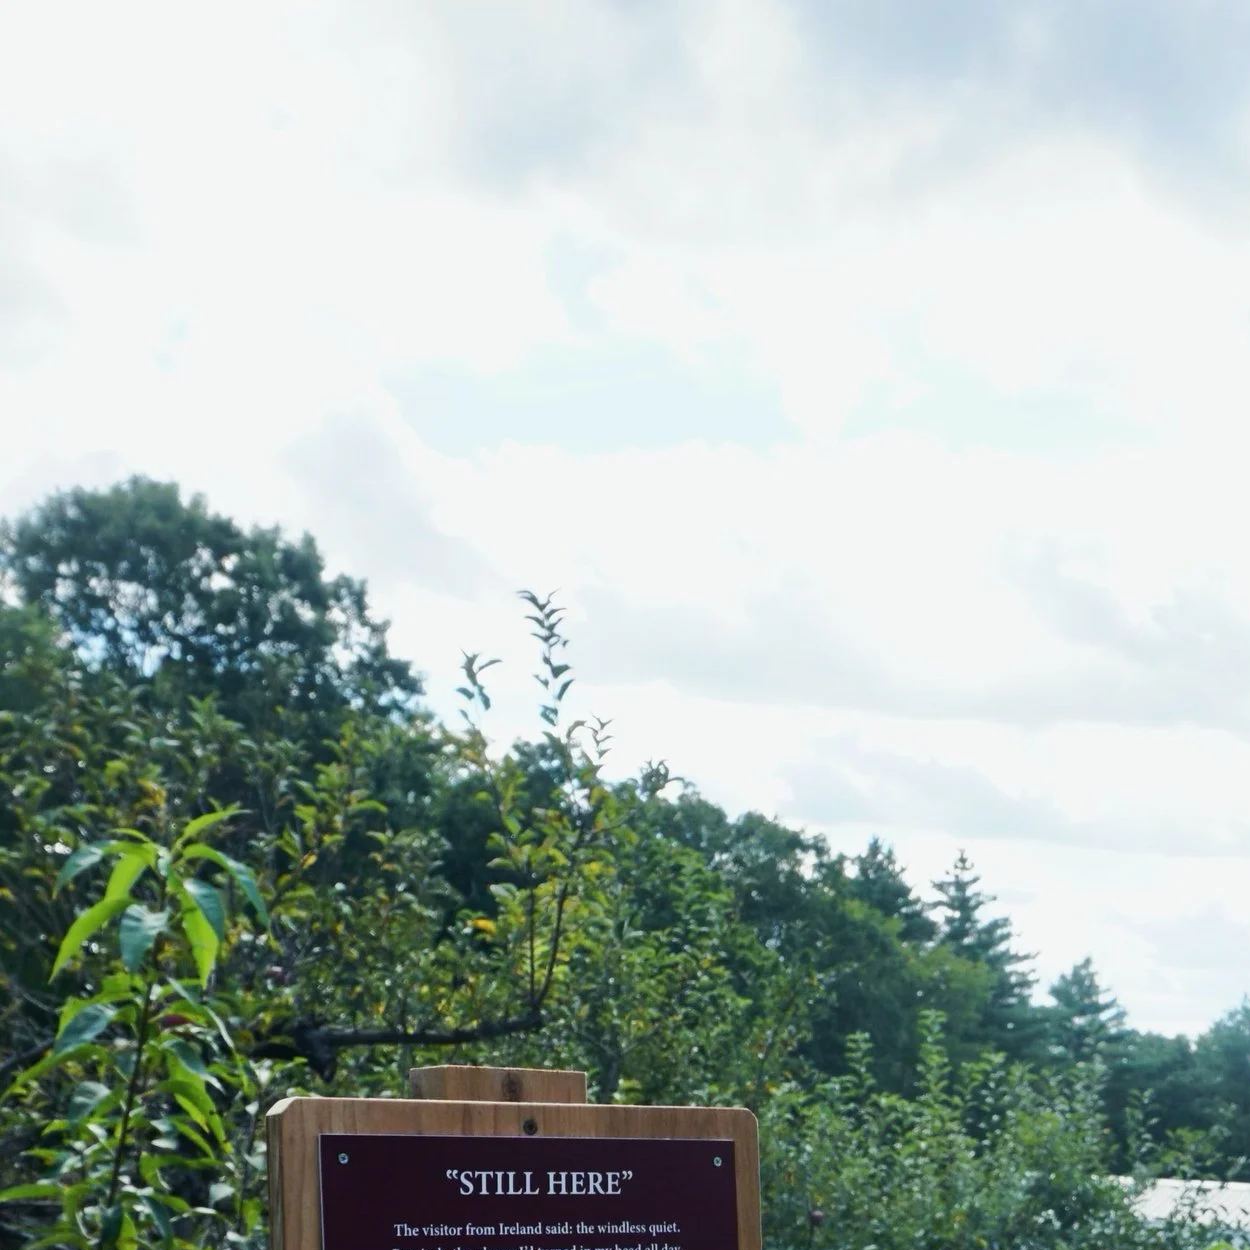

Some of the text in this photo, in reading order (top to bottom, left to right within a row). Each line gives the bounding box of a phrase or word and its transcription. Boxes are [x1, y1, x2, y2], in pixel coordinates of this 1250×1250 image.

[445, 1169, 634, 1196] “STILL HERE”
[393, 1220, 681, 1237] The visitor from Ireland said: the windless quiet.
